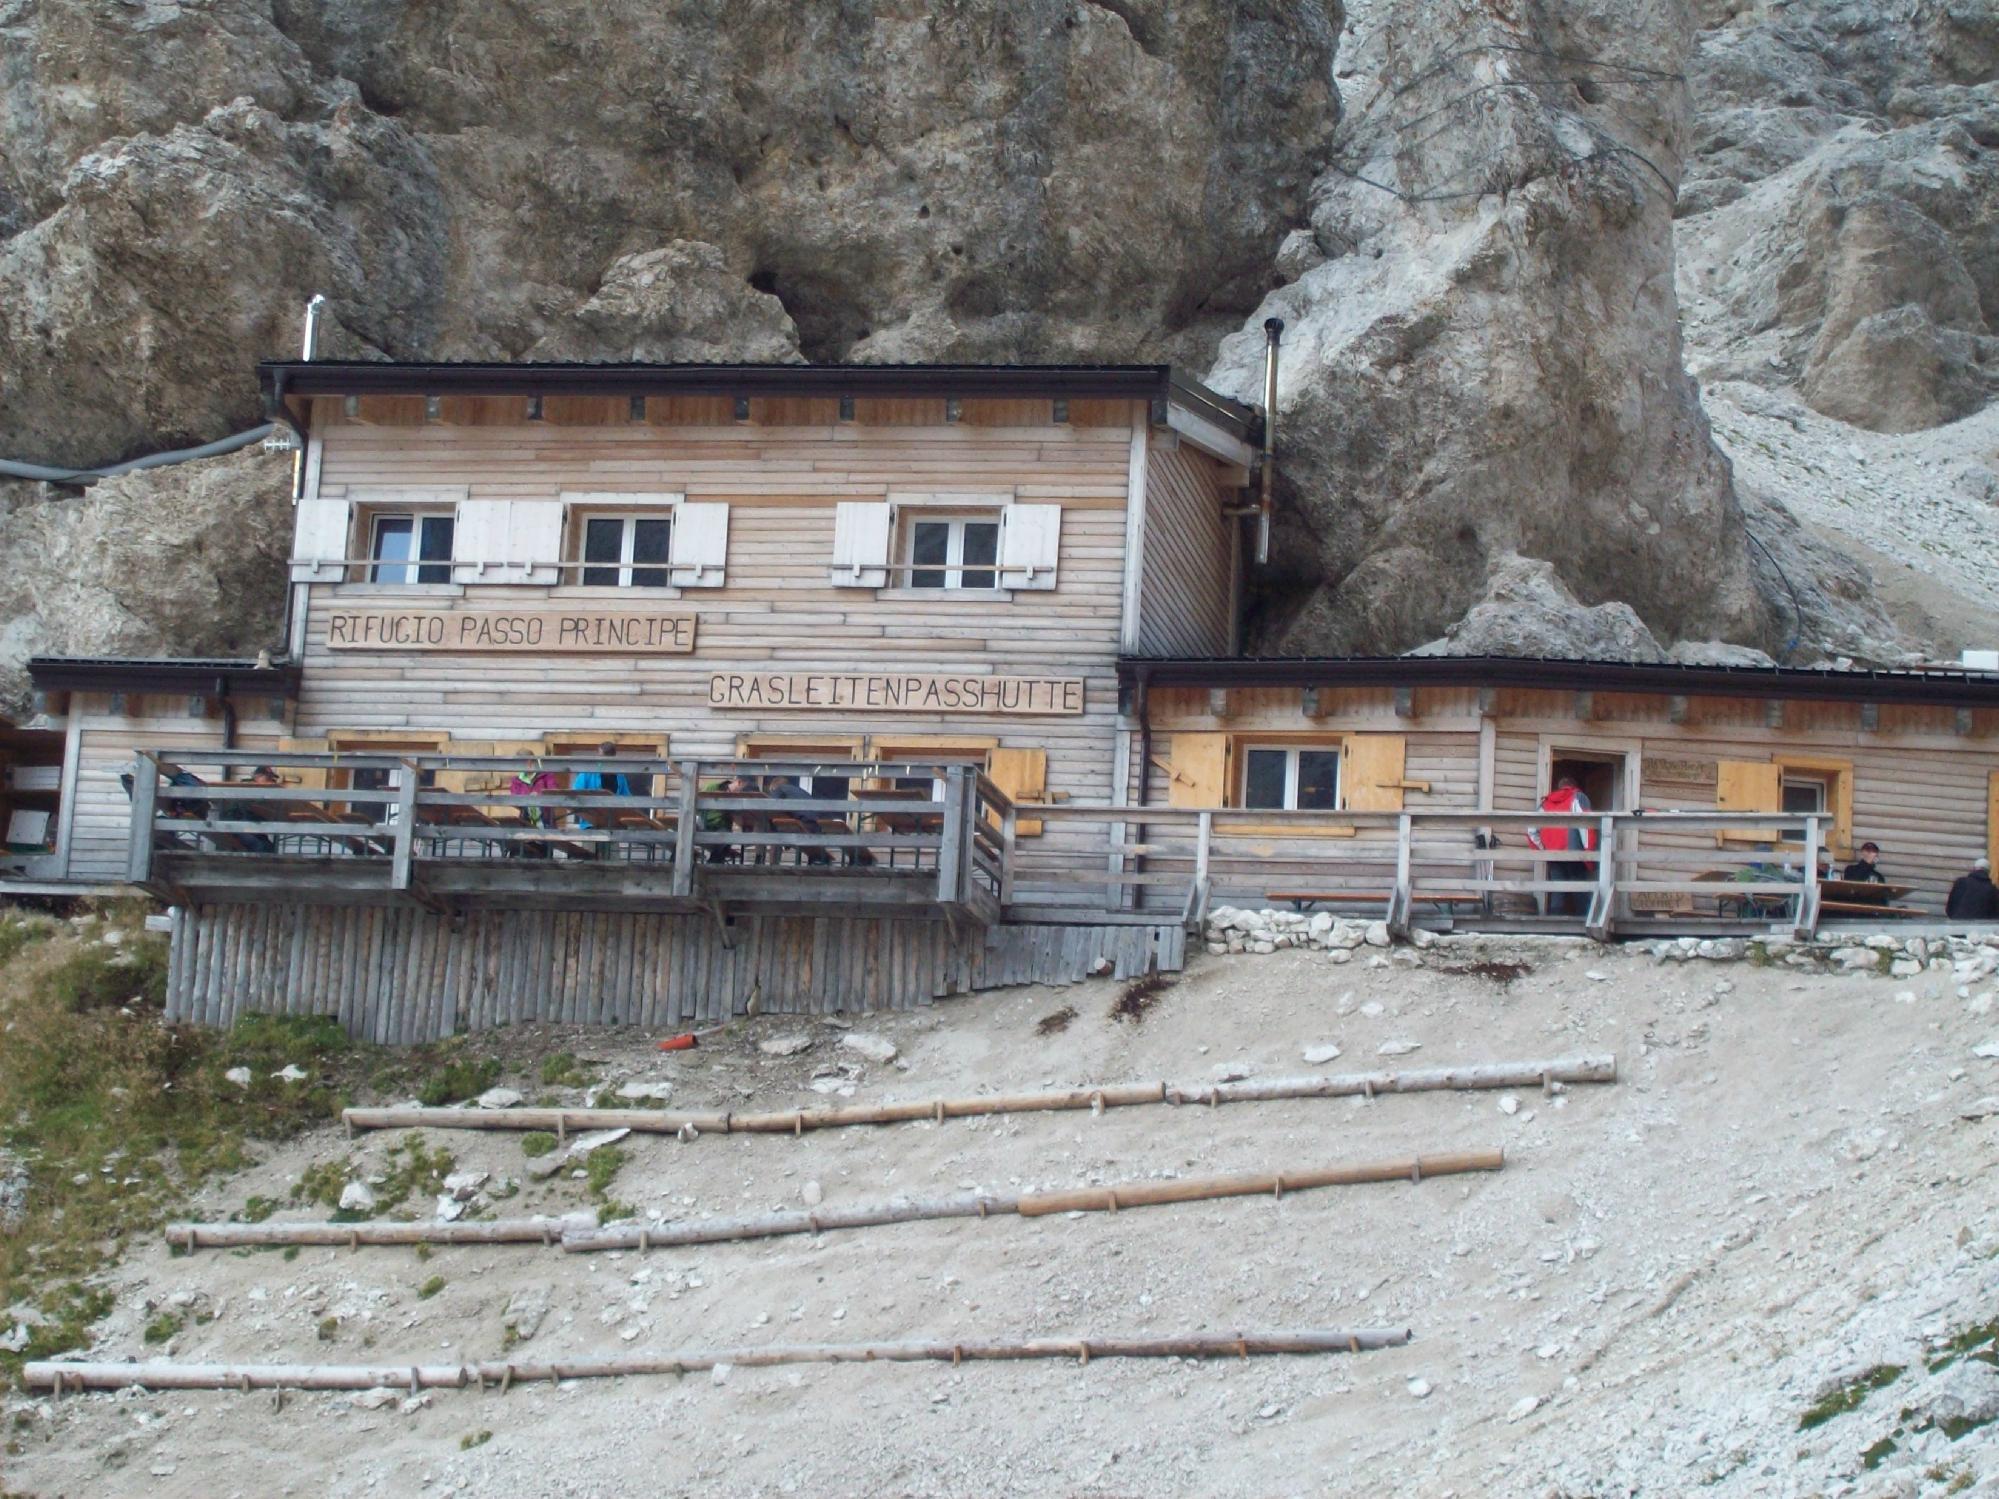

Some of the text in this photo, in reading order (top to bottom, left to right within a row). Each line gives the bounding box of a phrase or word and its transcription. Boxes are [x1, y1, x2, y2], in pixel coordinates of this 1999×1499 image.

[330, 616, 690, 646] RIFUGIO PASSO PRINCIPE
